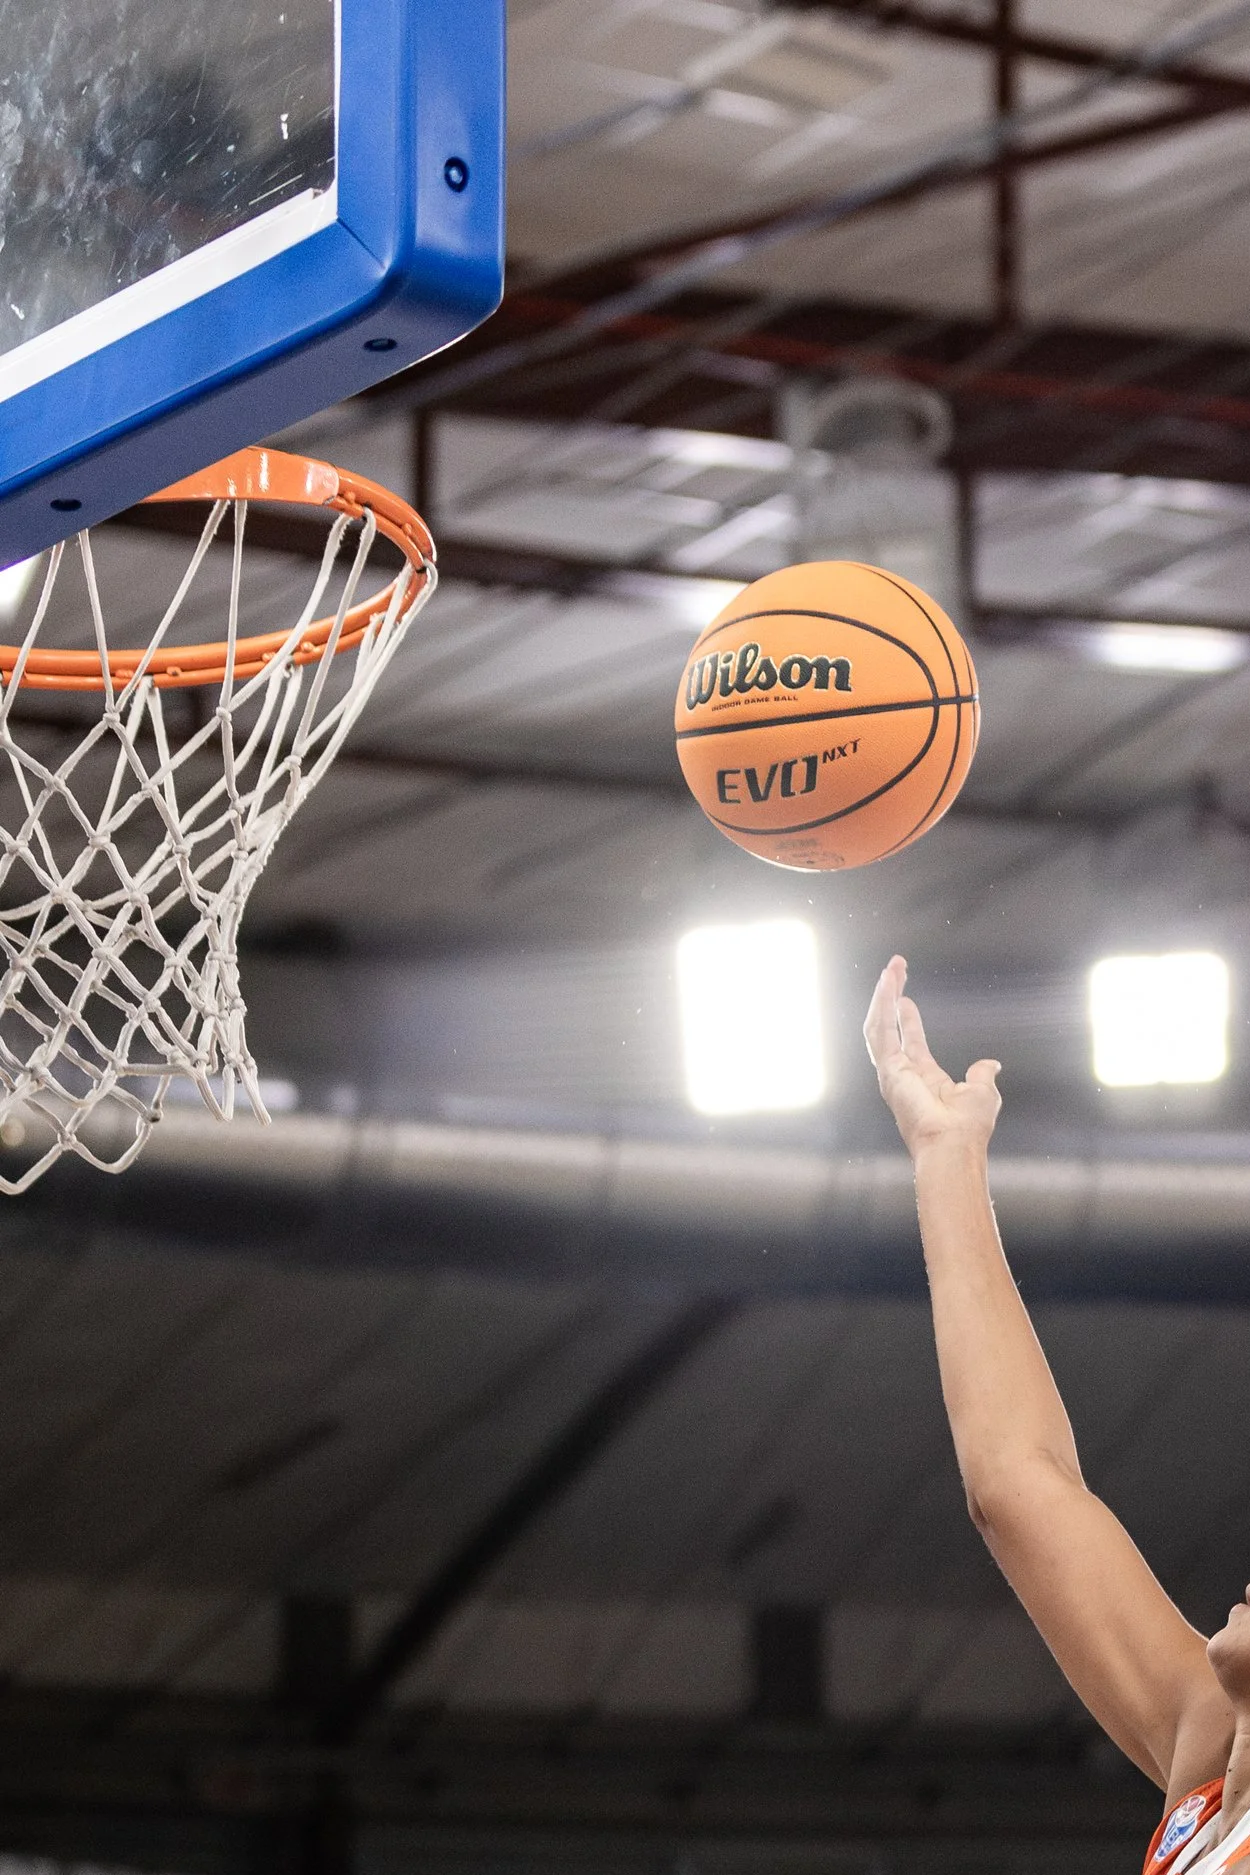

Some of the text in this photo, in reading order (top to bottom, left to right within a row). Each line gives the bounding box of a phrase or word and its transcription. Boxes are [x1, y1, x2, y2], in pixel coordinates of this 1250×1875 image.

[686, 641, 852, 711] Wilson
[774, 694, 798, 702] BALL
[716, 738, 861, 803] EVO NXT
